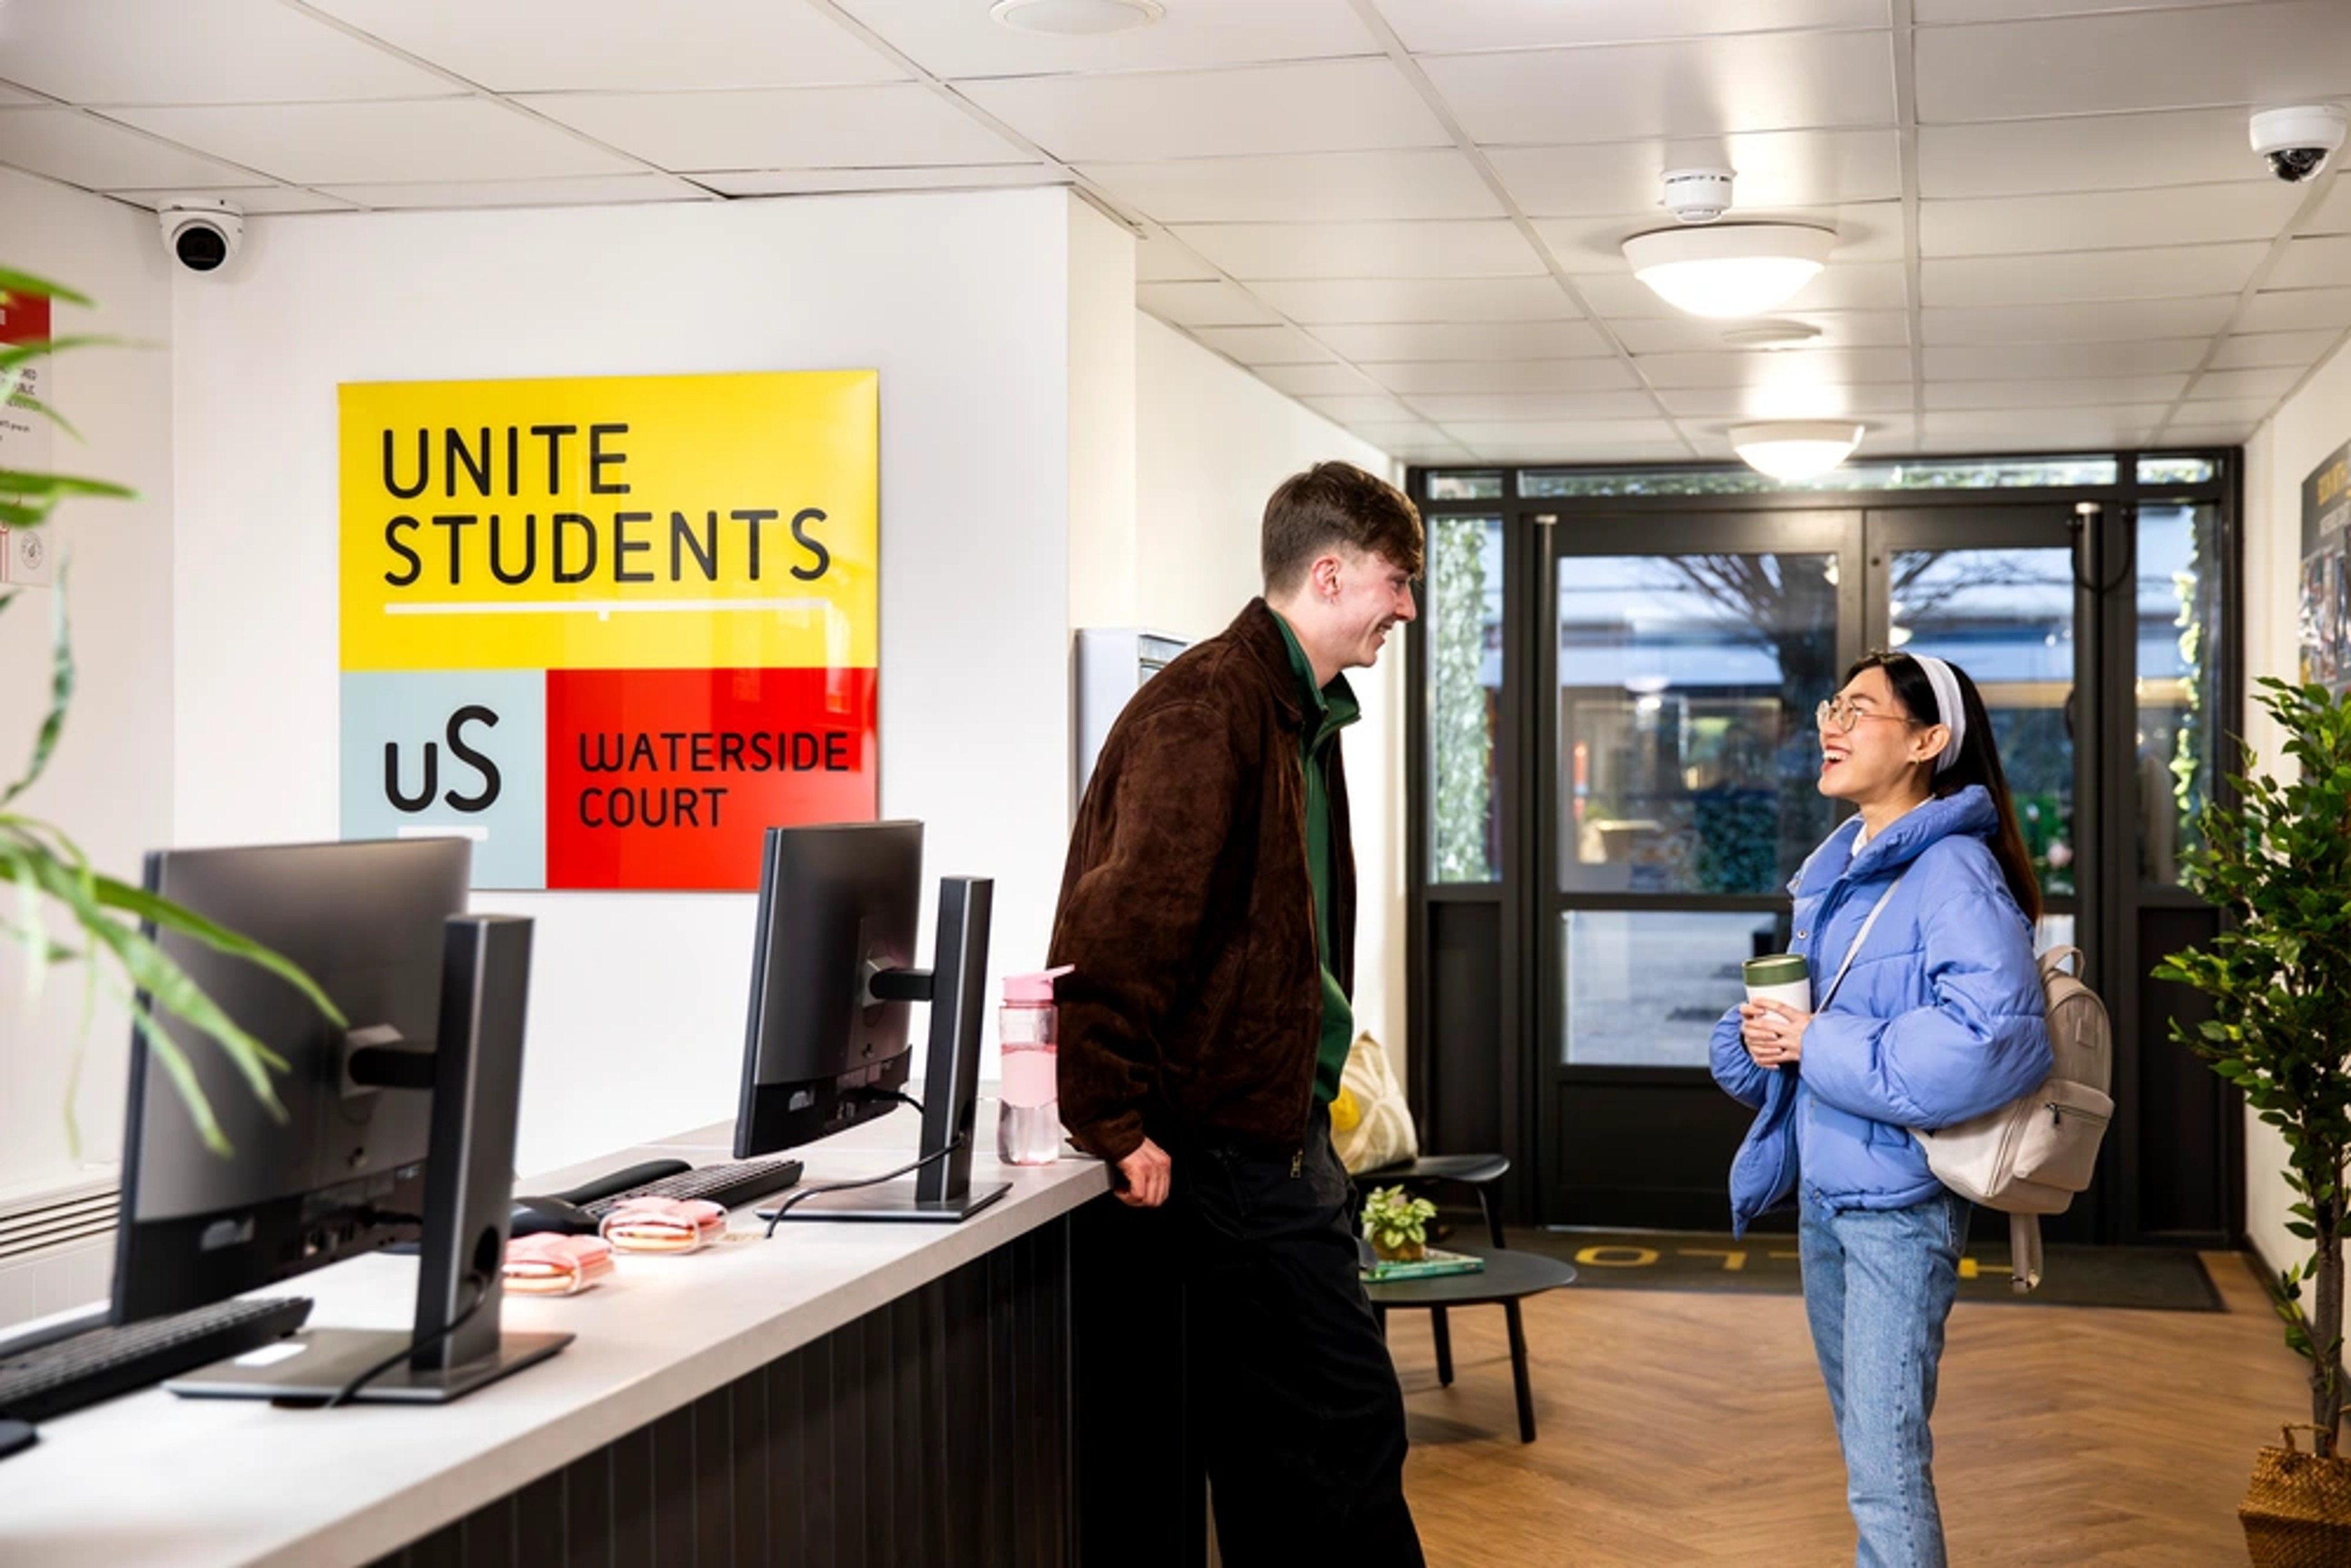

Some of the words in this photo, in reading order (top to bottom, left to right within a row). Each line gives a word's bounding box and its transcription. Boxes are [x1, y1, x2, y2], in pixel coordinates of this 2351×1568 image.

[383, 424, 631, 500] UNITE
[384, 508, 831, 587] STUDENTS
[579, 732, 849, 773] WATERSIDE
[579, 787, 728, 828] COURT
